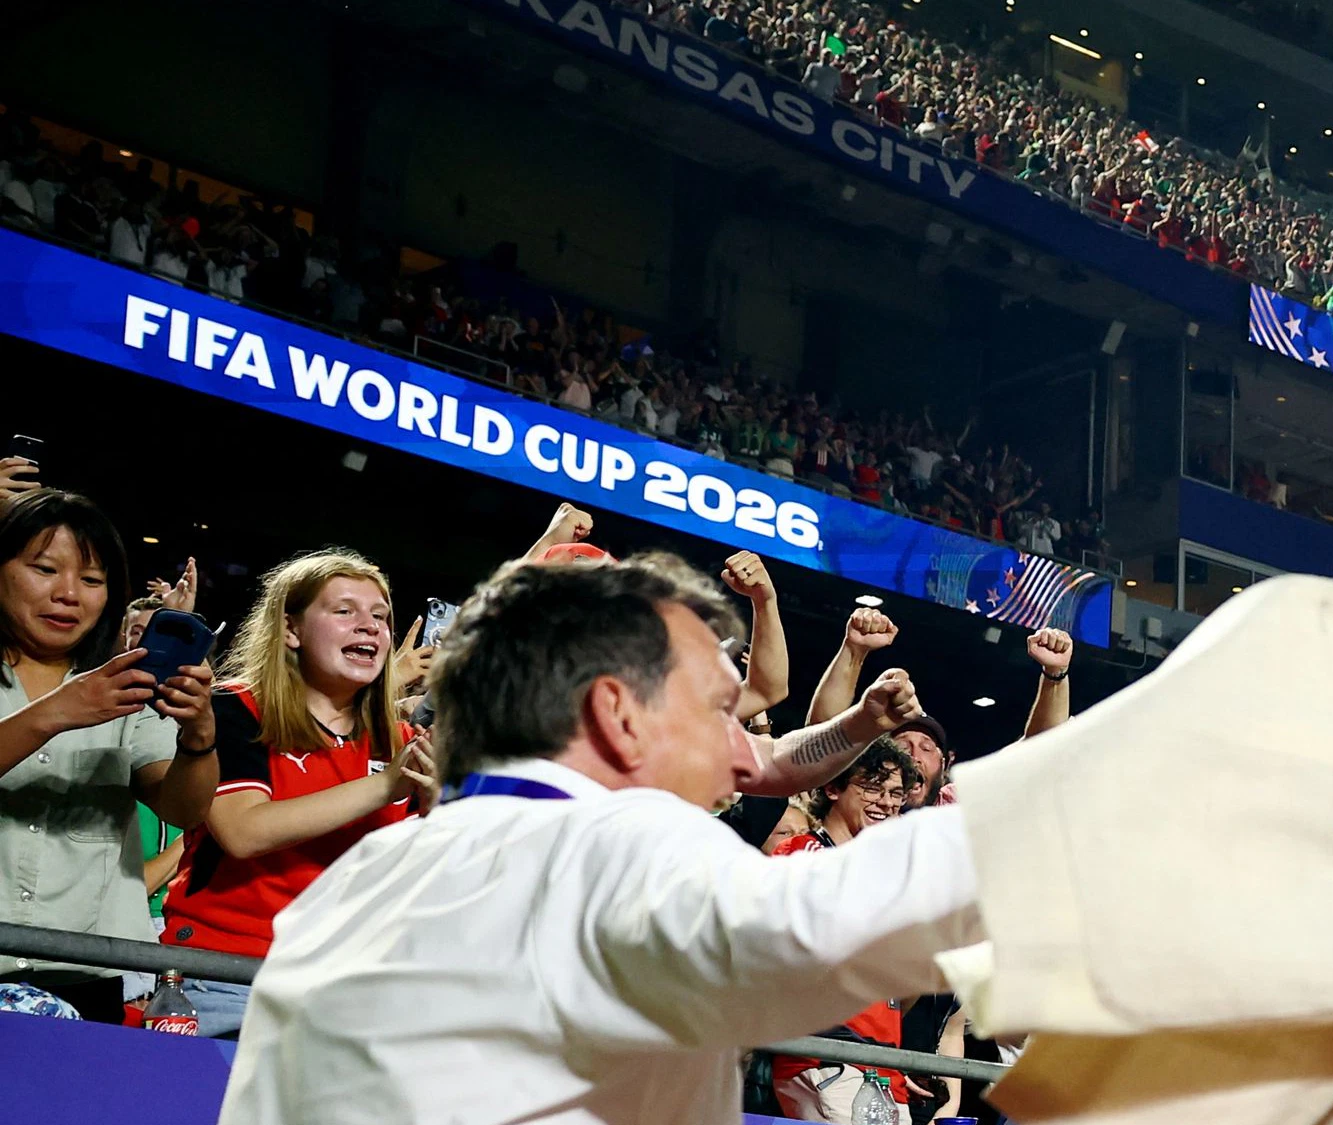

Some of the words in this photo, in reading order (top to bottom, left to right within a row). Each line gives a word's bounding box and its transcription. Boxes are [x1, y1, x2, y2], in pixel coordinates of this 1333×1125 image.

[831, 119, 977, 199] CITY
[124, 294, 276, 390] FIFA
[288, 346, 514, 456] WORLD
[524, 424, 636, 491] CUP
[643, 460, 821, 549] 2026
